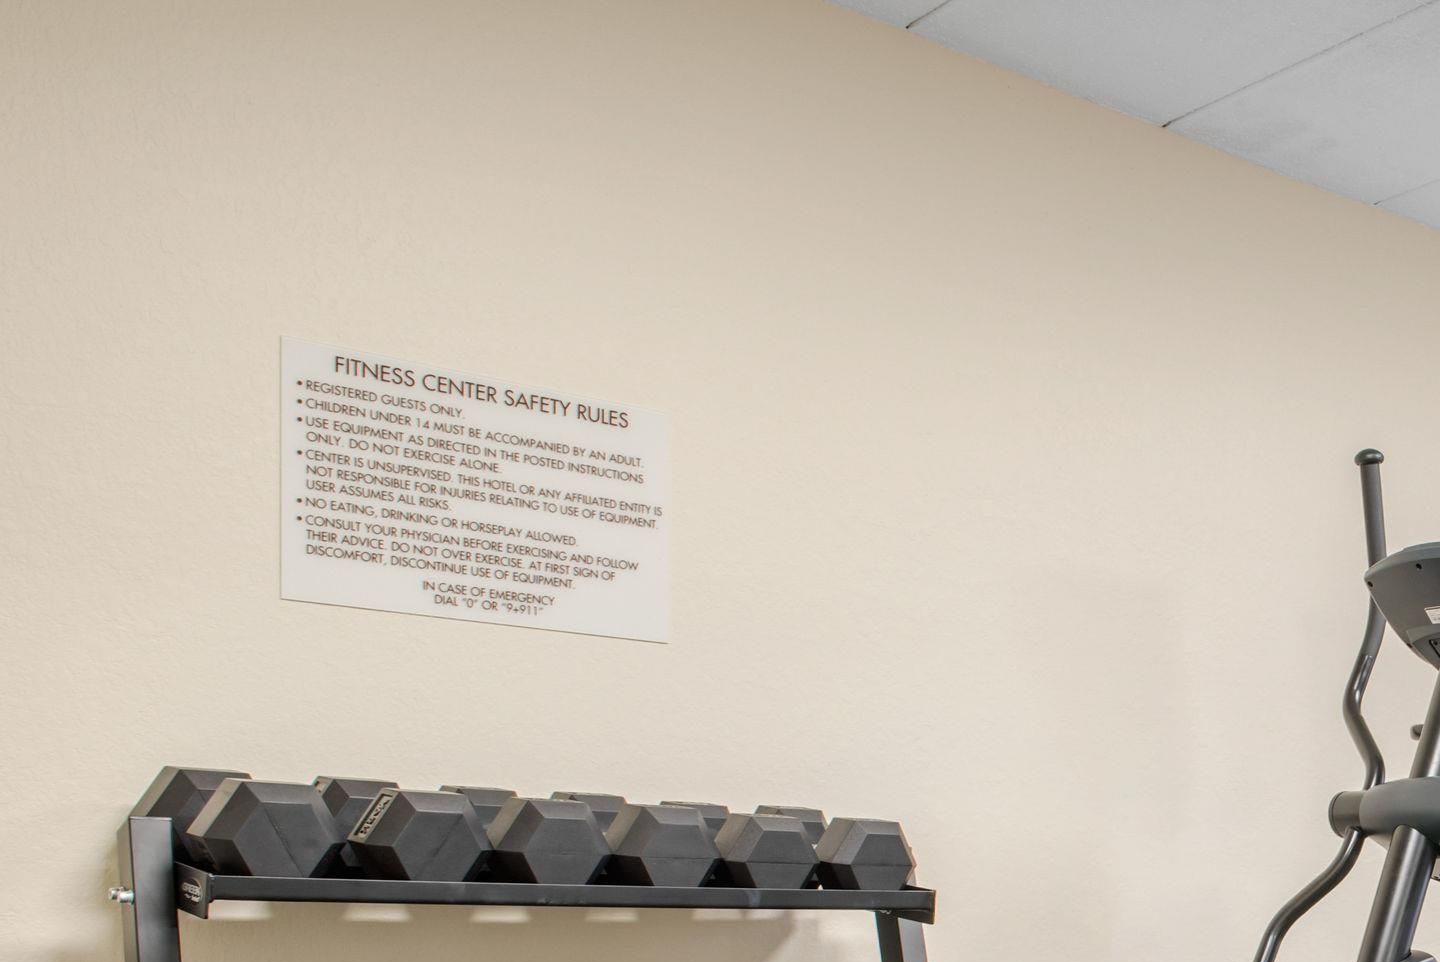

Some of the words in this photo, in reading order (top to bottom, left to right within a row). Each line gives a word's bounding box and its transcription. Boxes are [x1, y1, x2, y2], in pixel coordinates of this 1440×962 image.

[305, 379, 377, 402] REGISTERED
[380, 393, 426, 412] GUESTS
[428, 402, 464, 418] ONLY.
[333, 355, 416, 387] FITNESS
[421, 373, 498, 404] CENTER
[503, 388, 571, 417] SAFETY
[576, 402, 629, 429] RULES
[304, 397, 366, 418] CHILDREN
[369, 409, 411, 426] UNDER
[416, 417, 430, 429] 14
[432, 421, 465, 435] MUST
[467, 426, 481, 439] BE
[484, 430, 570, 454] ACCOMPANIED
[572, 445, 586, 456] BY
[588, 449, 606, 461] AN
[608, 453, 643, 467] ADULT.
[304, 415, 329, 429] USE
[332, 420, 404, 442] EQUIPMENT
[407, 434, 424, 446] AS
[426, 436, 481, 455] DIRECTED
[483, 447, 497, 458] IN
[499, 449, 520, 463] THE
[522, 453, 565, 470] POSTED
[567, 461, 644, 484] INSTRUCTIONS
[305, 430, 343, 446] ONLY.
[348, 437, 369, 451] DO
[372, 442, 400, 456] NOT
[402, 447, 455, 466] EXERCISE
[458, 457, 501, 473] ALONE.
[304, 448, 350, 465] CENTER
[353, 456, 364, 468] IS
[366, 459, 453, 482] UNSUPERVISED.
[456, 473, 480, 487] THIS
[482, 478, 517, 493] HOTEL
[518, 483, 535, 495] OR
[537, 487, 561, 499] ANY
[563, 491, 617, 508] AFFILIATED
[618, 500, 651, 514] ENTITY
[653, 505, 662, 516] IS
[305, 478, 335, 493] USER
[338, 484, 394, 502] ASSUMES
[396, 493, 416, 505] ALL
[418, 496, 453, 511] RISKS.
[305, 463, 333, 477] NOT
[336, 468, 410, 490] RESPONSIBLE
[413, 481, 436, 494] FOR
[439, 485, 486, 502] INJURIES
[488, 492, 540, 510] RELATING
[542, 501, 557, 513] TO
[559, 505, 579, 517] USE
[580, 508, 596, 519] OF
[598, 510, 659, 529] EQUIPMENT.
[304, 496, 327, 509] NO
[329, 499, 377, 518] EATING,
[380, 507, 438, 525] DRINKING
[440, 516, 458, 528] OR
[460, 519, 523, 537] HORSEPLAY
[524, 529, 578, 546] ALLOWED.
[304, 514, 361, 531] CONSULT
[363, 522, 397, 537] YOUR
[399, 527, 460, 545] PHYSICIAN
[462, 536, 503, 552] BEFORE
[505, 542, 567, 561] EXERCISING
[569, 553, 594, 565] AND
[595, 555, 639, 571] FOLLOW
[304, 543, 387, 565] DISCOMFORT,
[389, 554, 467, 575] DISCONTINUE
[469, 565, 491, 578] USE
[493, 568, 509, 580] OF
[512, 571, 575, 589] EQUIPMENT.
[305, 528, 337, 543] THEIR
[340, 534, 386, 550] ADVICE.
[390, 540, 410, 553] DO
[412, 544, 438, 556] NOT
[440, 547, 472, 561] OVER
[474, 552, 524, 568] EXERCISE.
[528, 560, 542, 570] AT
[544, 562, 570, 574] FIRST
[572, 565, 599, 578] SIGN
[600, 570, 615, 581] OF
[421, 580, 435, 591] IN
[437, 581, 467, 595] CASE
[469, 585, 486, 597] OF
[488, 588, 555, 606] EMERGENCY
[434, 593, 458, 607] DIAL
[481, 600, 498, 611] OR
